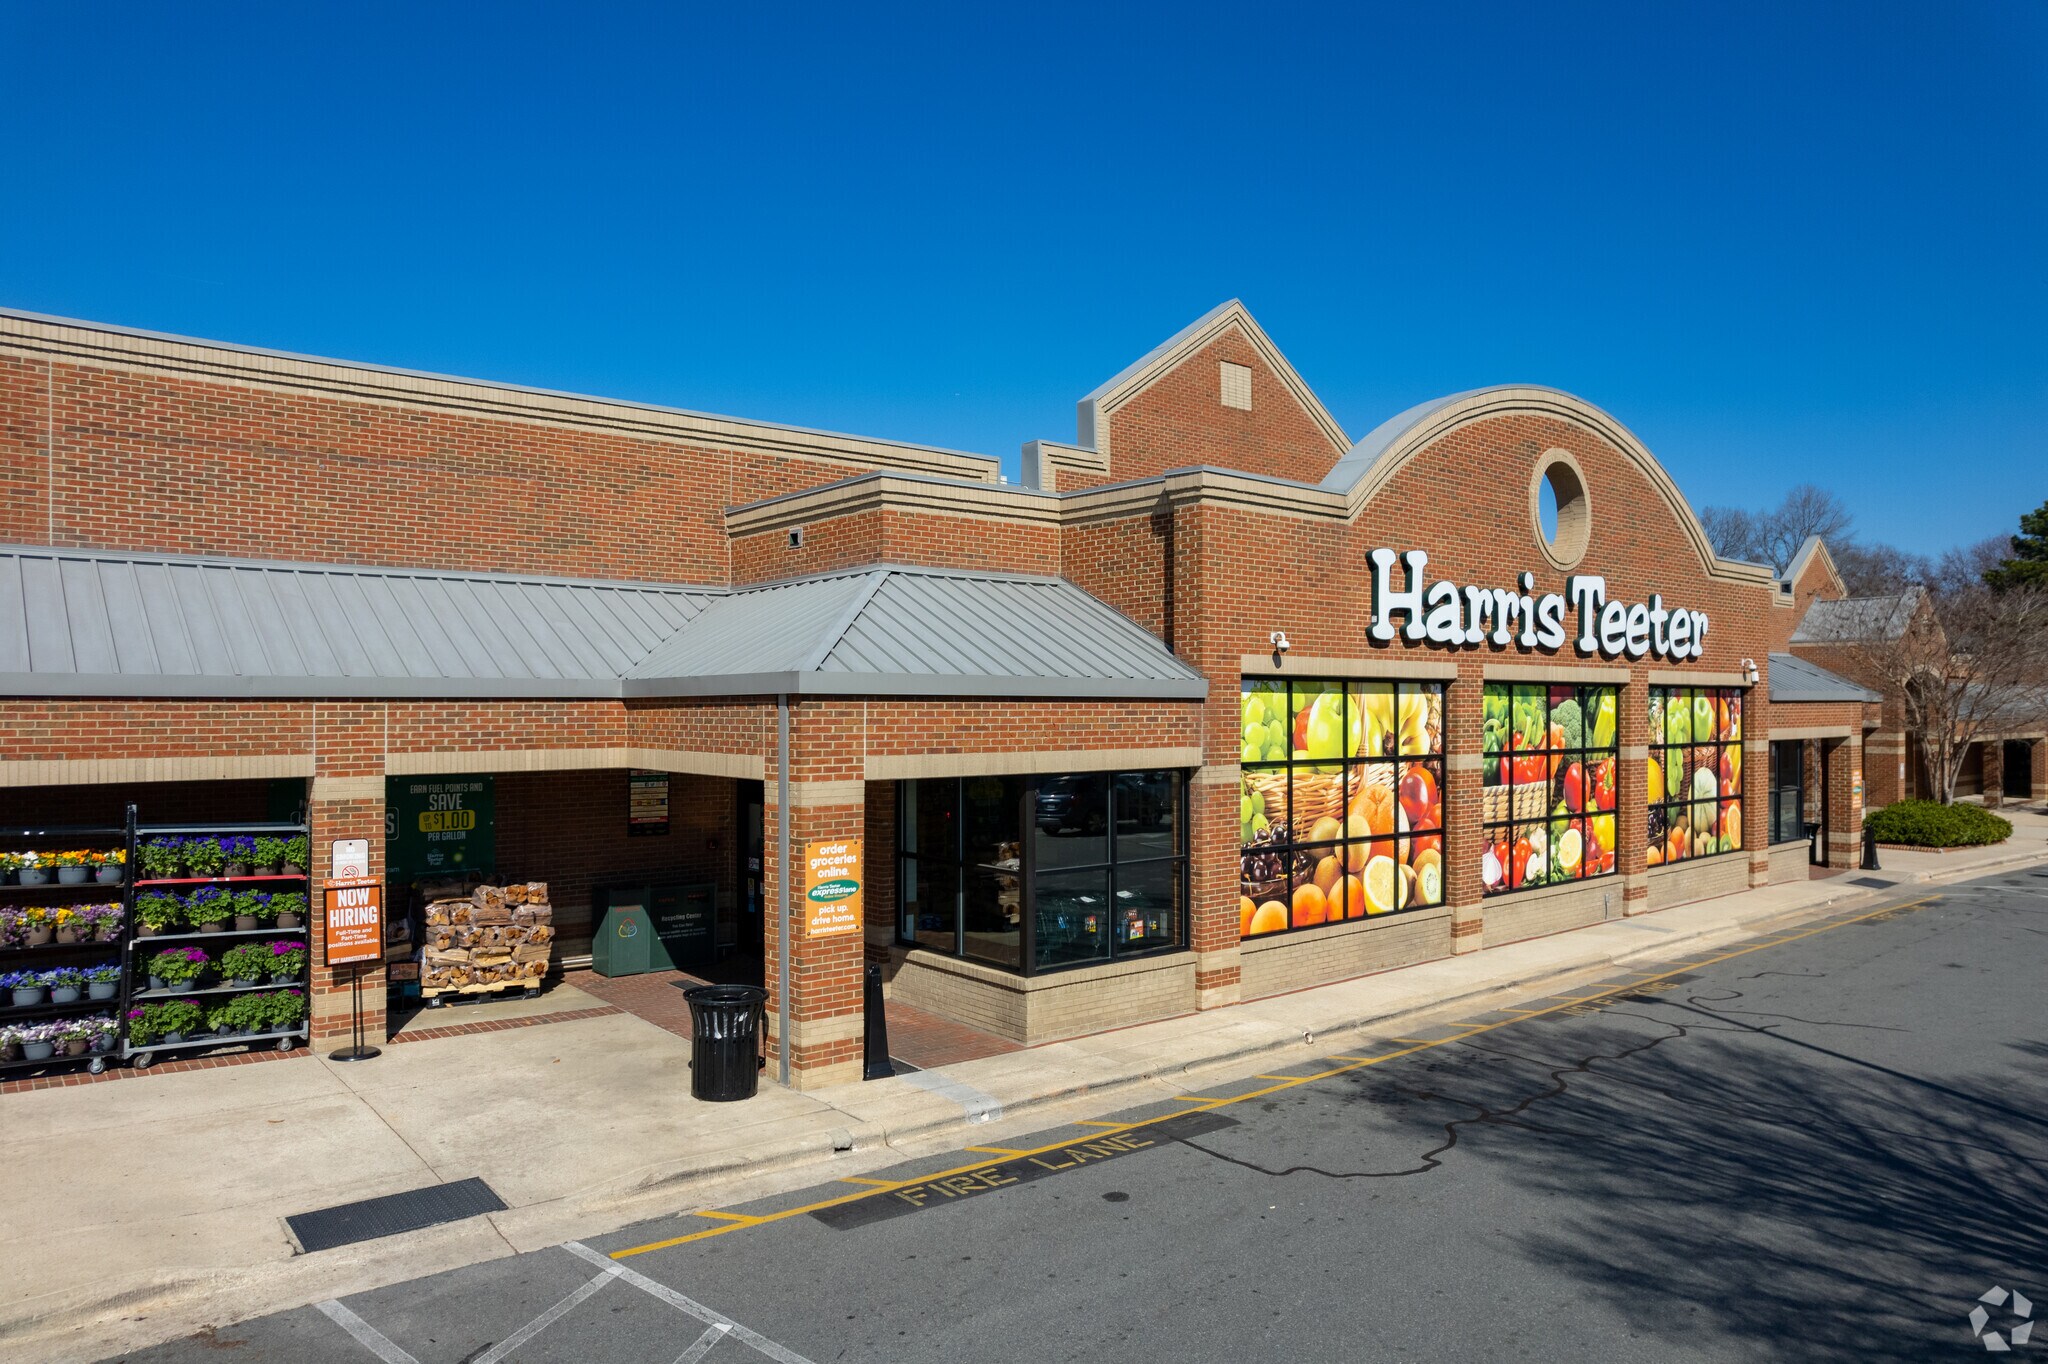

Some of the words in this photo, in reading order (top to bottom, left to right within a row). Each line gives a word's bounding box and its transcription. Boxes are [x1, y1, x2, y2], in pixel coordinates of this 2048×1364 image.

[1365, 548, 1566, 649] Harris
[1566, 575, 1709, 659] Teeter
[410, 785, 427, 794] EARN
[429, 784, 443, 793] FUEL
[445, 783, 468, 792] POINTS
[470, 783, 483, 792] AND
[429, 793, 463, 811] SAVE
[434, 811, 470, 830] $1.00
[428, 832, 440, 841] PER
[442, 831, 466, 840] GALLON
[819, 843, 847, 855] order
[810, 854, 857, 870] groceries
[817, 866, 850, 878] online.
[338, 887, 369, 907] NOW
[819, 904, 835, 916] pick
[837, 905, 848, 913] up.
[330, 906, 377, 928] HIRING
[661, 914, 685, 922] Recycling
[811, 916, 831, 926] drive
[832, 914, 856, 923] home.
[328, 941, 353, 949] positions
[894, 1168, 1018, 1207] FIRE
[1028, 1133, 1155, 1171] LANE
